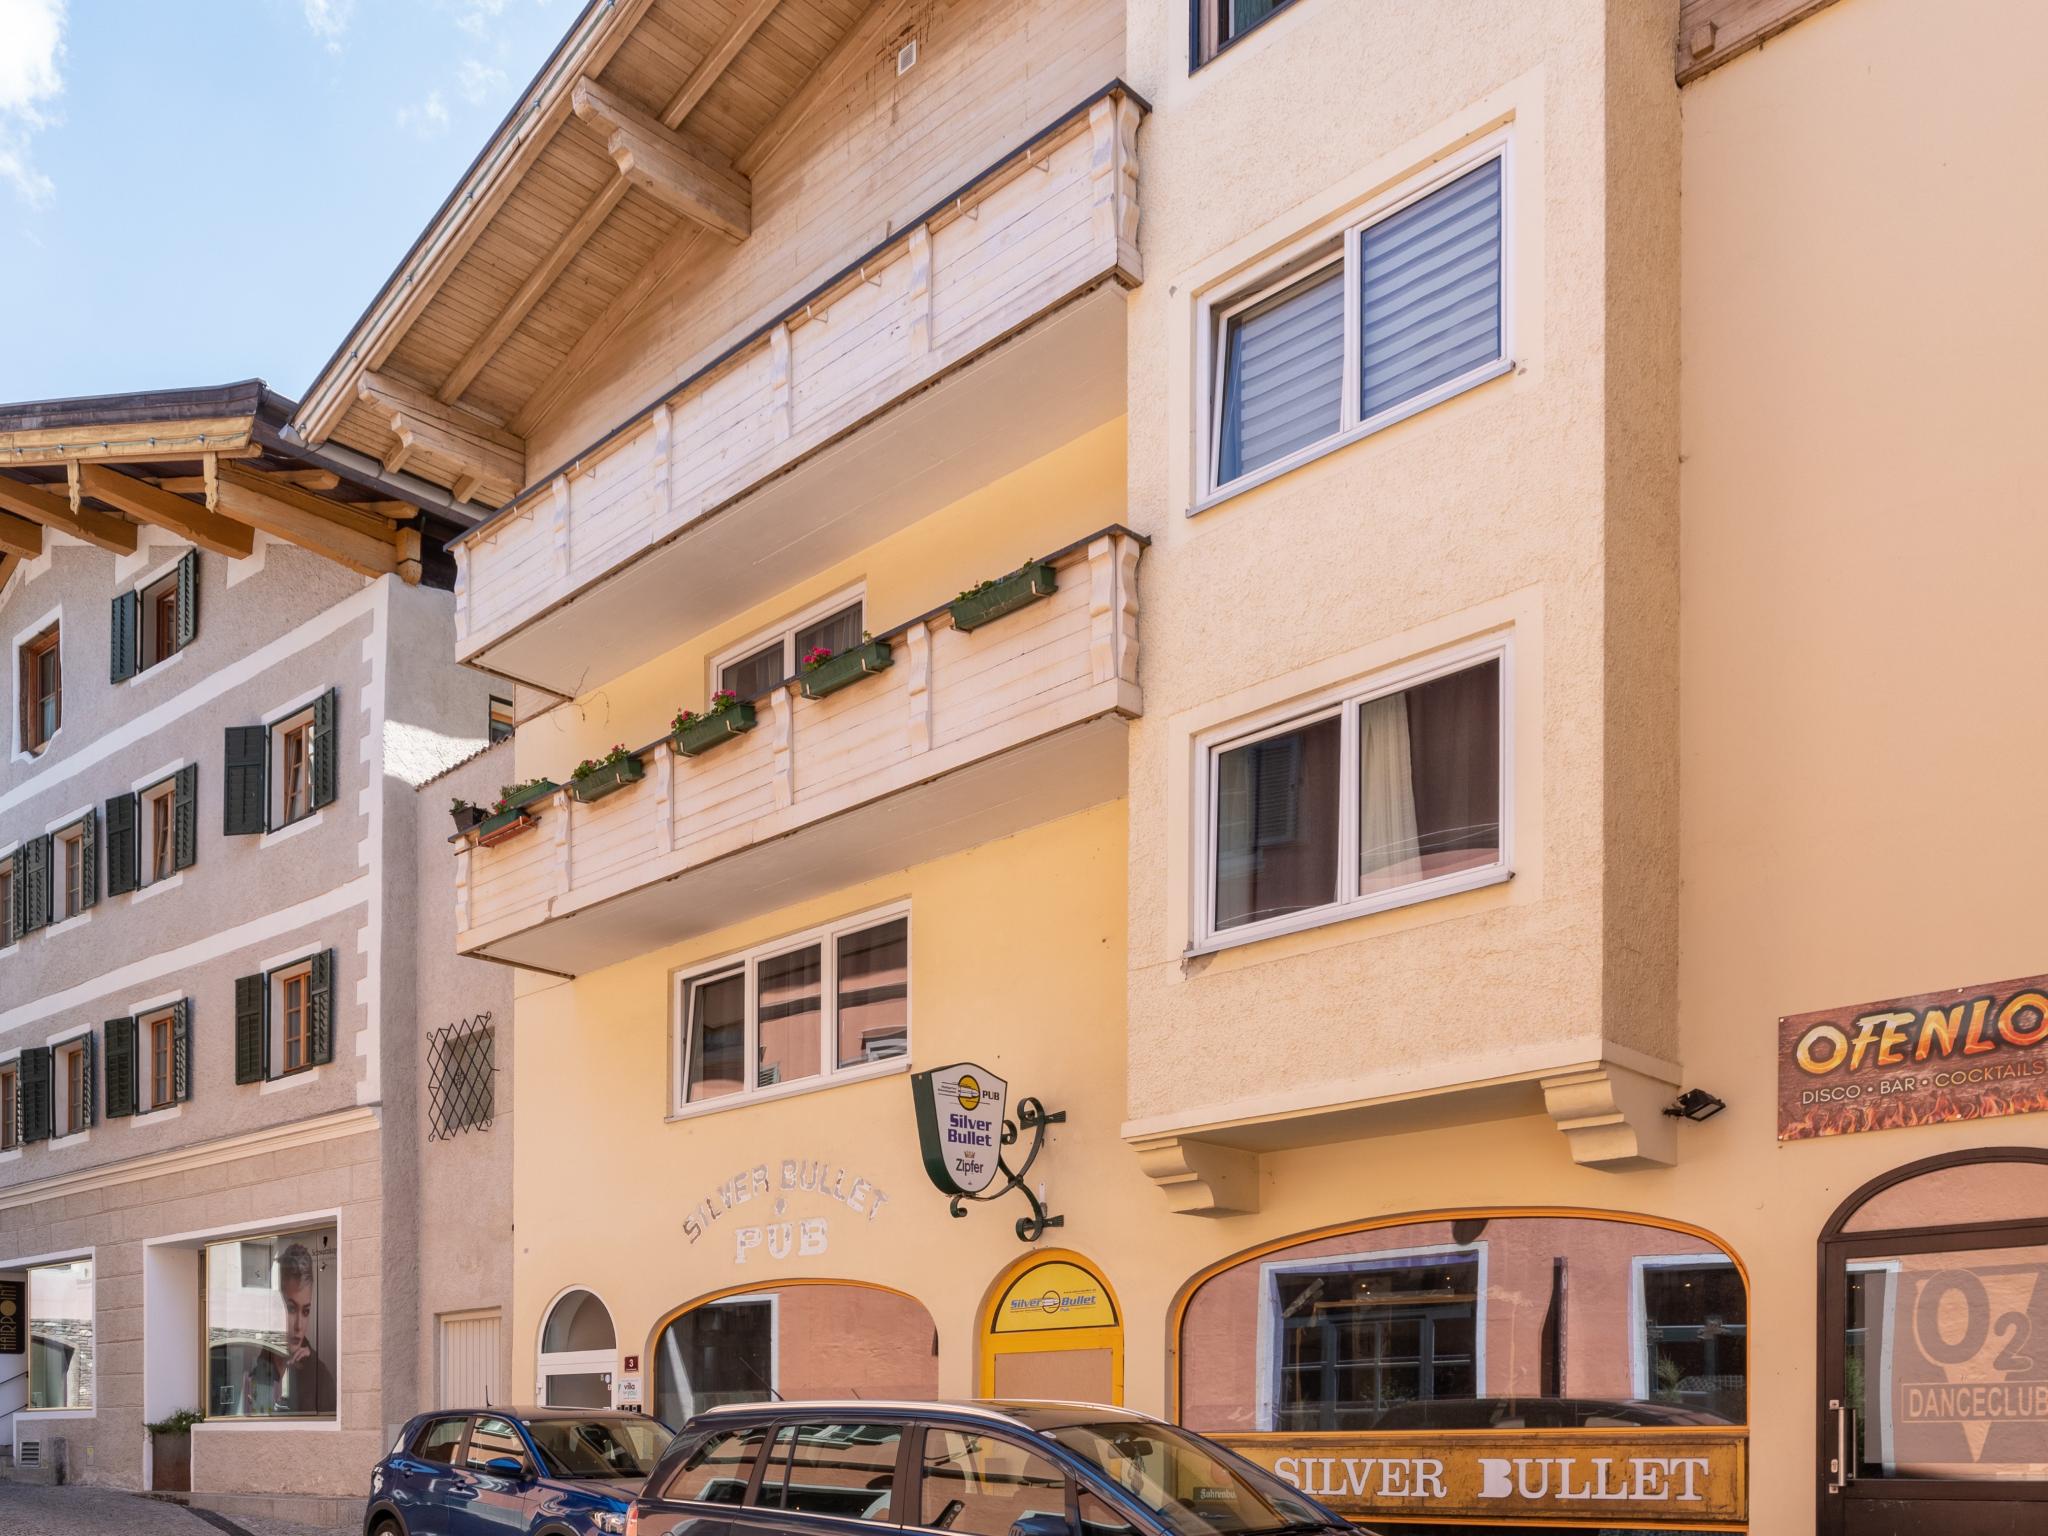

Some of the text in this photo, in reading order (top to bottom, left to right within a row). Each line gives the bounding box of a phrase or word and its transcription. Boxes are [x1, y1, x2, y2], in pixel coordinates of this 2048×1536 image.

[1802, 1060, 2045, 1104] DISCO BAR COCKTAILS
[982, 1090, 1000, 1100] PUB
[950, 1113, 992, 1131] Silver
[947, 1128, 992, 1147] Bullet
[956, 1158, 984, 1176] Zipfer
[682, 1159, 889, 1244] SILVER BULLET
[735, 1217, 828, 1264] PUB
[1011, 1296, 1096, 1308] Silver Bullet
[629, 1358, 634, 1368] 3
[1909, 1386, 2048, 1417] DANCECLUB
[1274, 1457, 1709, 1500] SILVER BULLET
